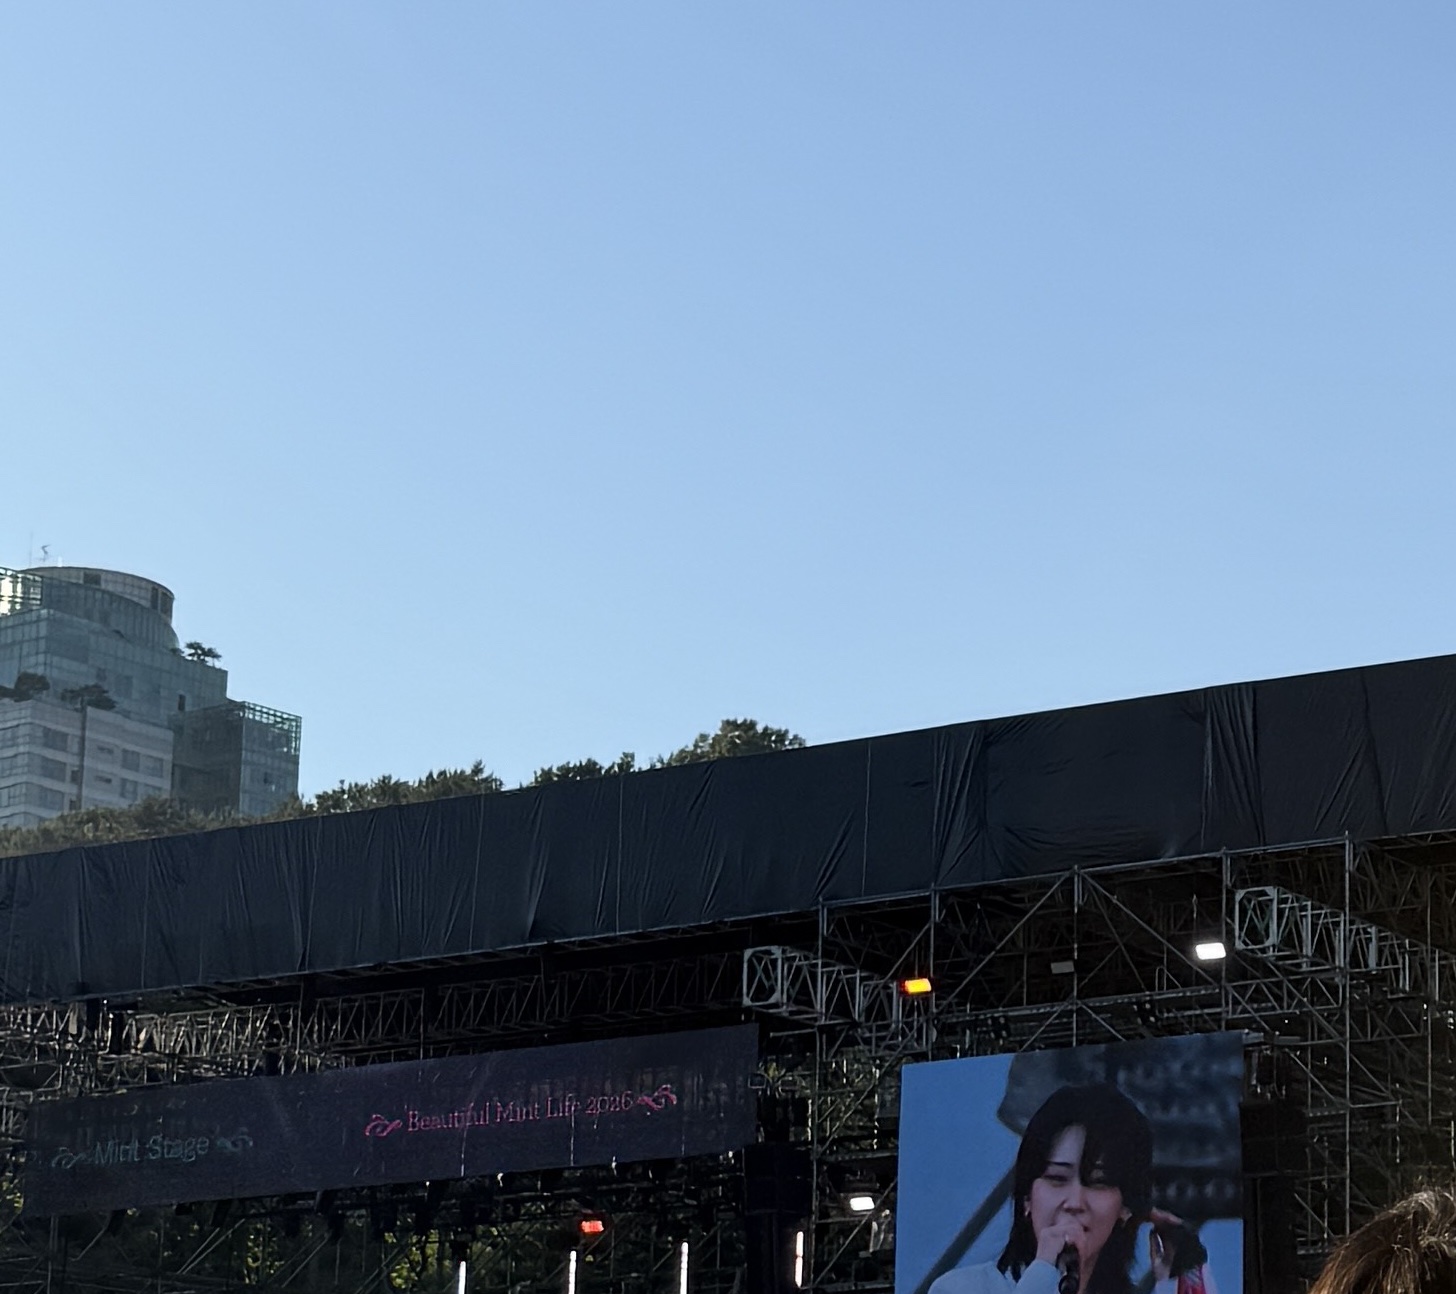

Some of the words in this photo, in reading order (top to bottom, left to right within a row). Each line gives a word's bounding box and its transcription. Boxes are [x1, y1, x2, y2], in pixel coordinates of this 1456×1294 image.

[406, 1101, 490, 1132] Beautiful
[496, 1101, 541, 1123] Mint
[546, 1093, 581, 1118] Life
[147, 1134, 210, 1162] Stage
